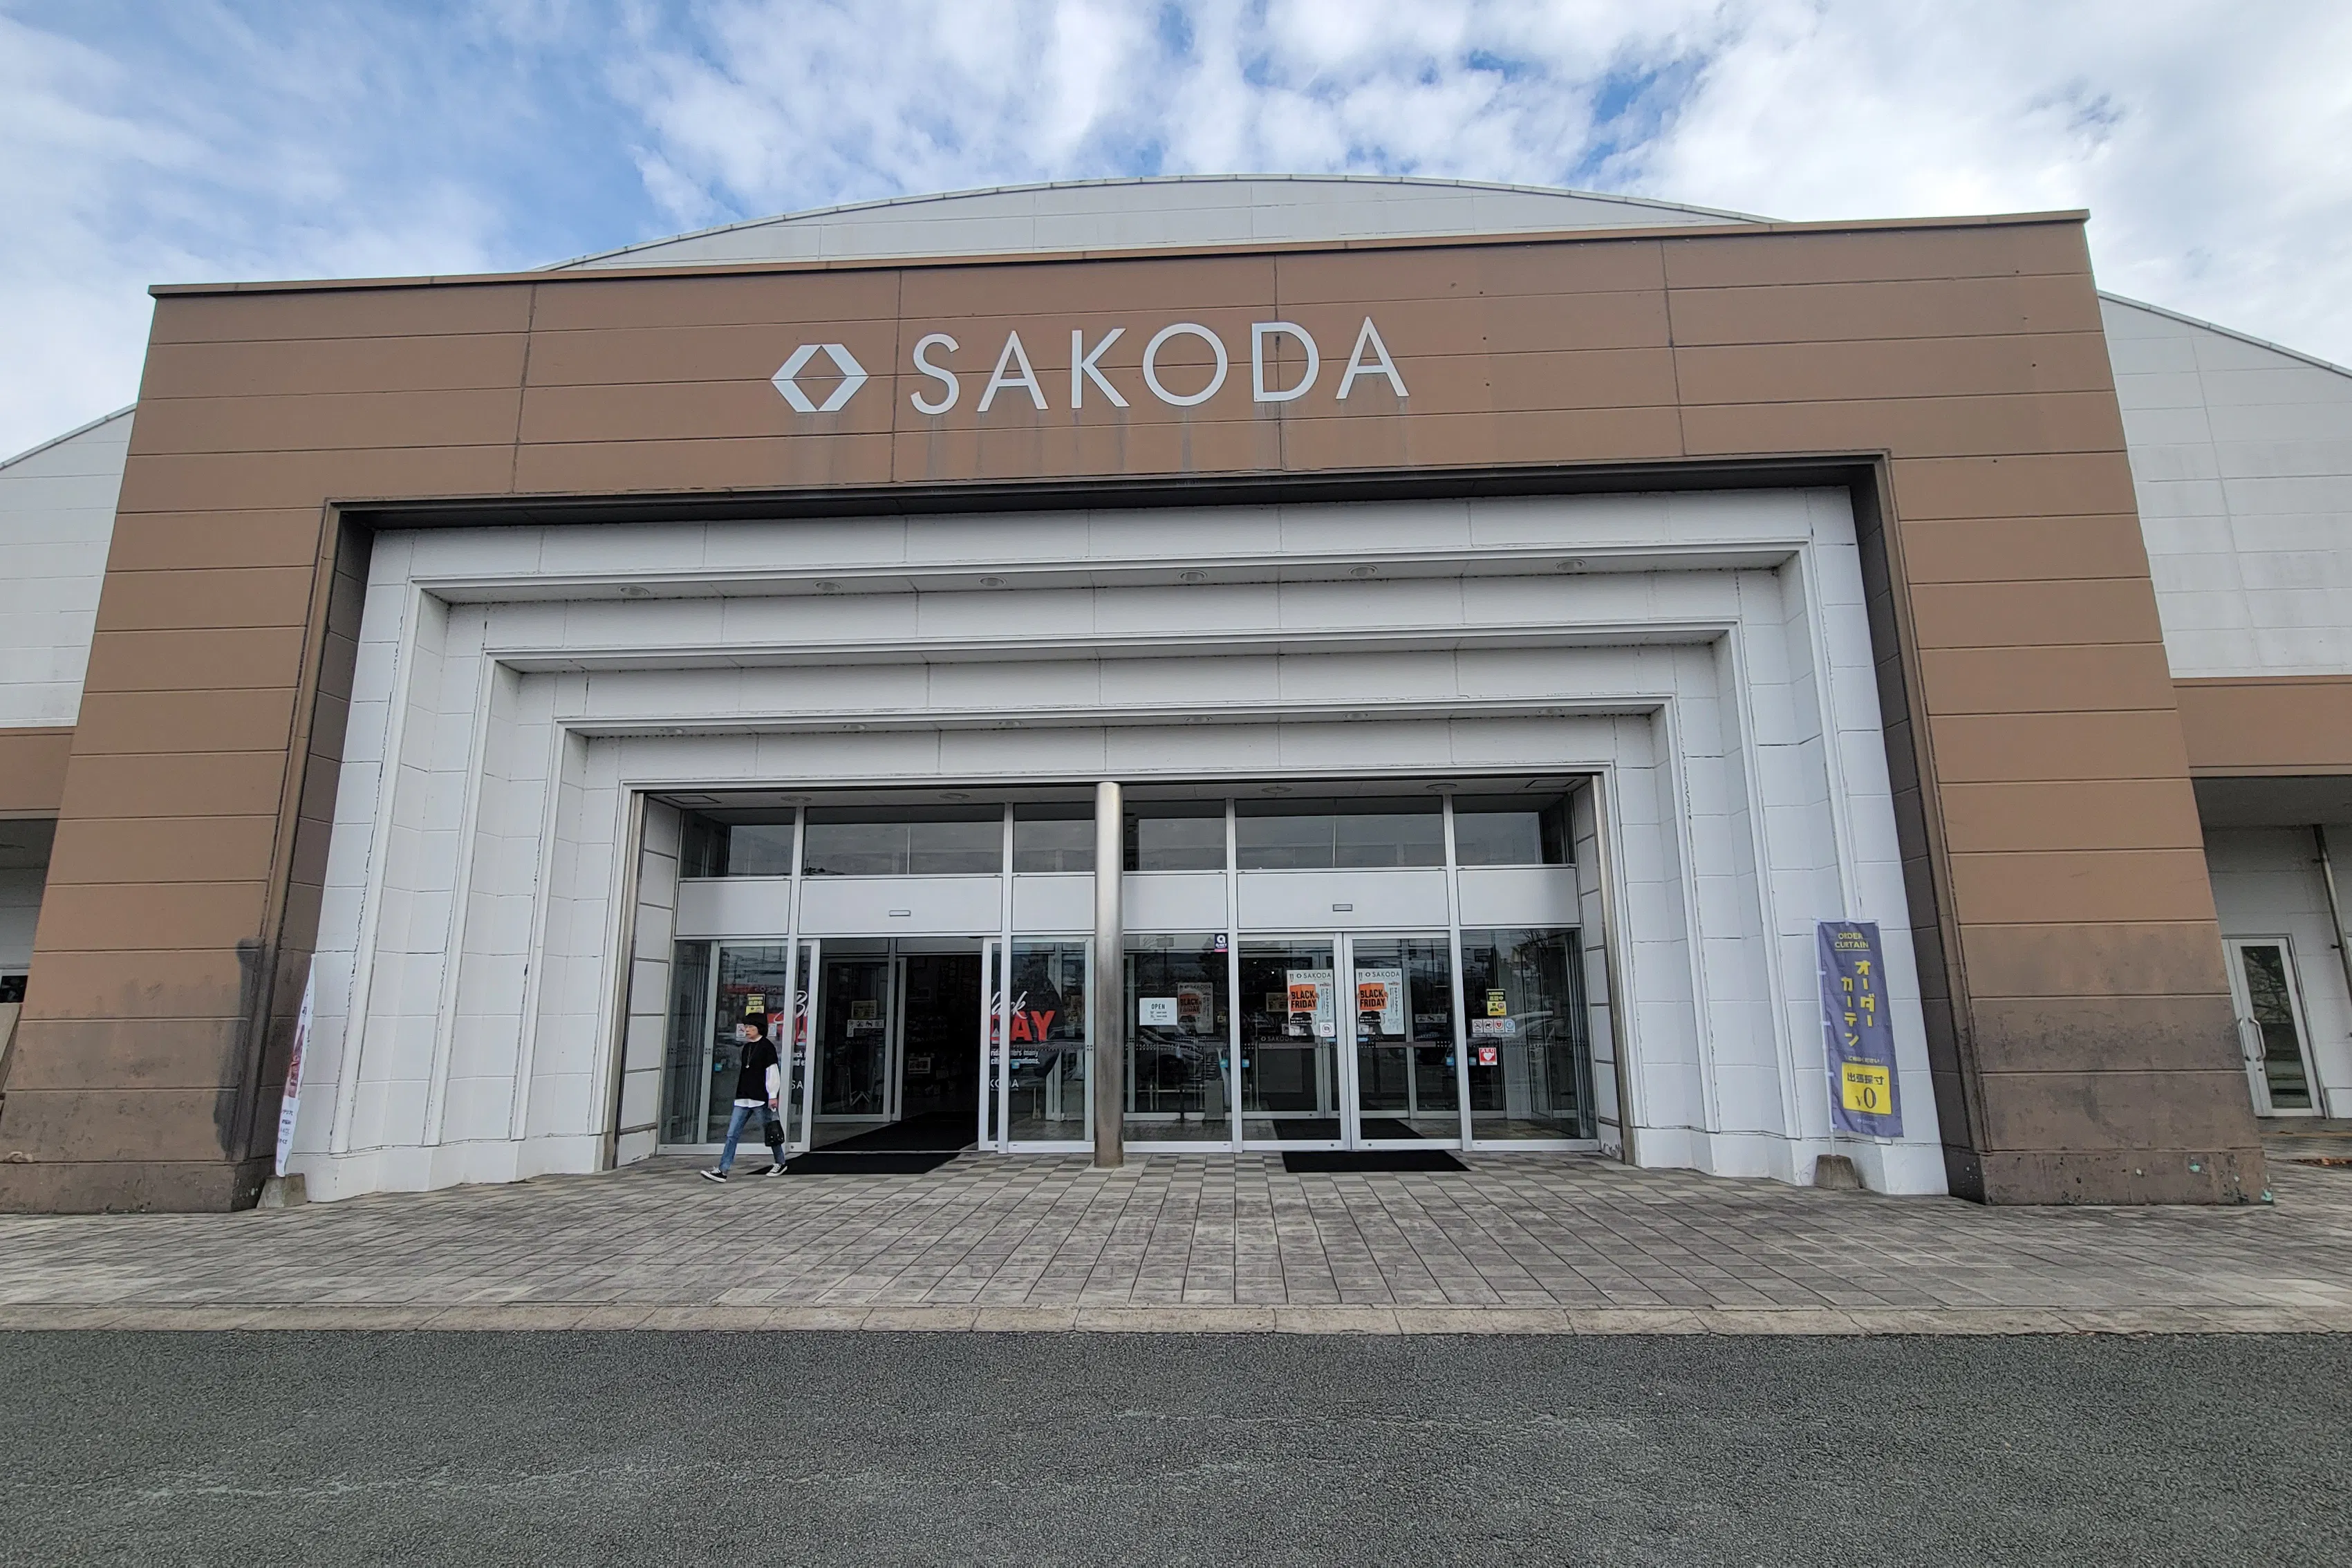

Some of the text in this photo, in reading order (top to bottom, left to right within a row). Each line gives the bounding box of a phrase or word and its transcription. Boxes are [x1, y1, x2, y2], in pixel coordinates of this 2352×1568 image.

[910, 315, 1410, 416] SAKODA
[1291, 990, 1315, 1000] BLACK
[1360, 989, 1383, 998] BLACK
[1855, 959, 1876, 1028] オーダー
[1291, 999, 1316, 1009] FRIDAY
[1360, 998, 1385, 1007] FRIDAY
[1840, 976, 1860, 1047] カーテン
